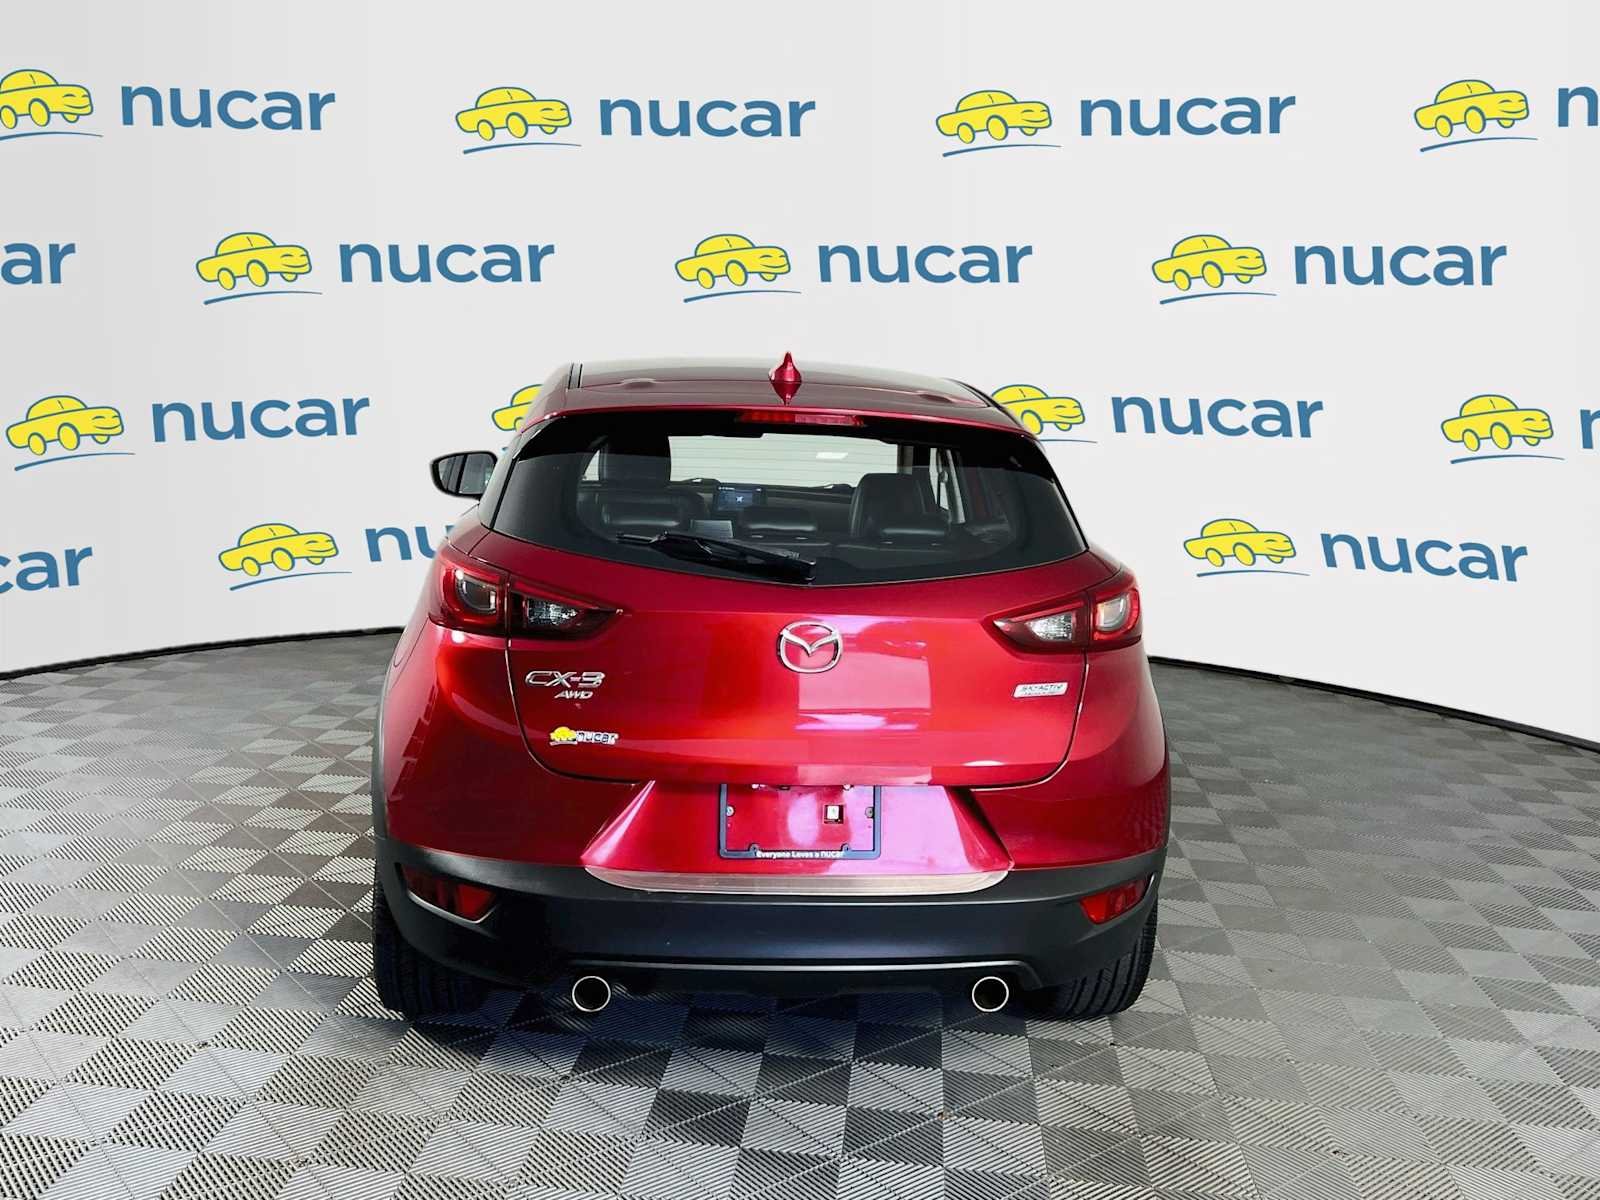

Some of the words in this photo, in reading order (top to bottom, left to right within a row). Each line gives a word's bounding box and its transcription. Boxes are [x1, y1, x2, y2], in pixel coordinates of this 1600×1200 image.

[121, 84, 336, 131] nucar
[599, 97, 817, 138] nucar
[1080, 95, 1296, 137] nucar
[338, 242, 556, 284] nucar
[818, 244, 1033, 284] nucar
[1294, 244, 1508, 287] nucar
[150, 396, 370, 443] nucar
[1111, 395, 1324, 439] nucar
[1320, 532, 1528, 582] nucar
[525, 670, 606, 688] CX-3
[555, 690, 594, 700] AWD
[576, 730, 618, 745] nucar
